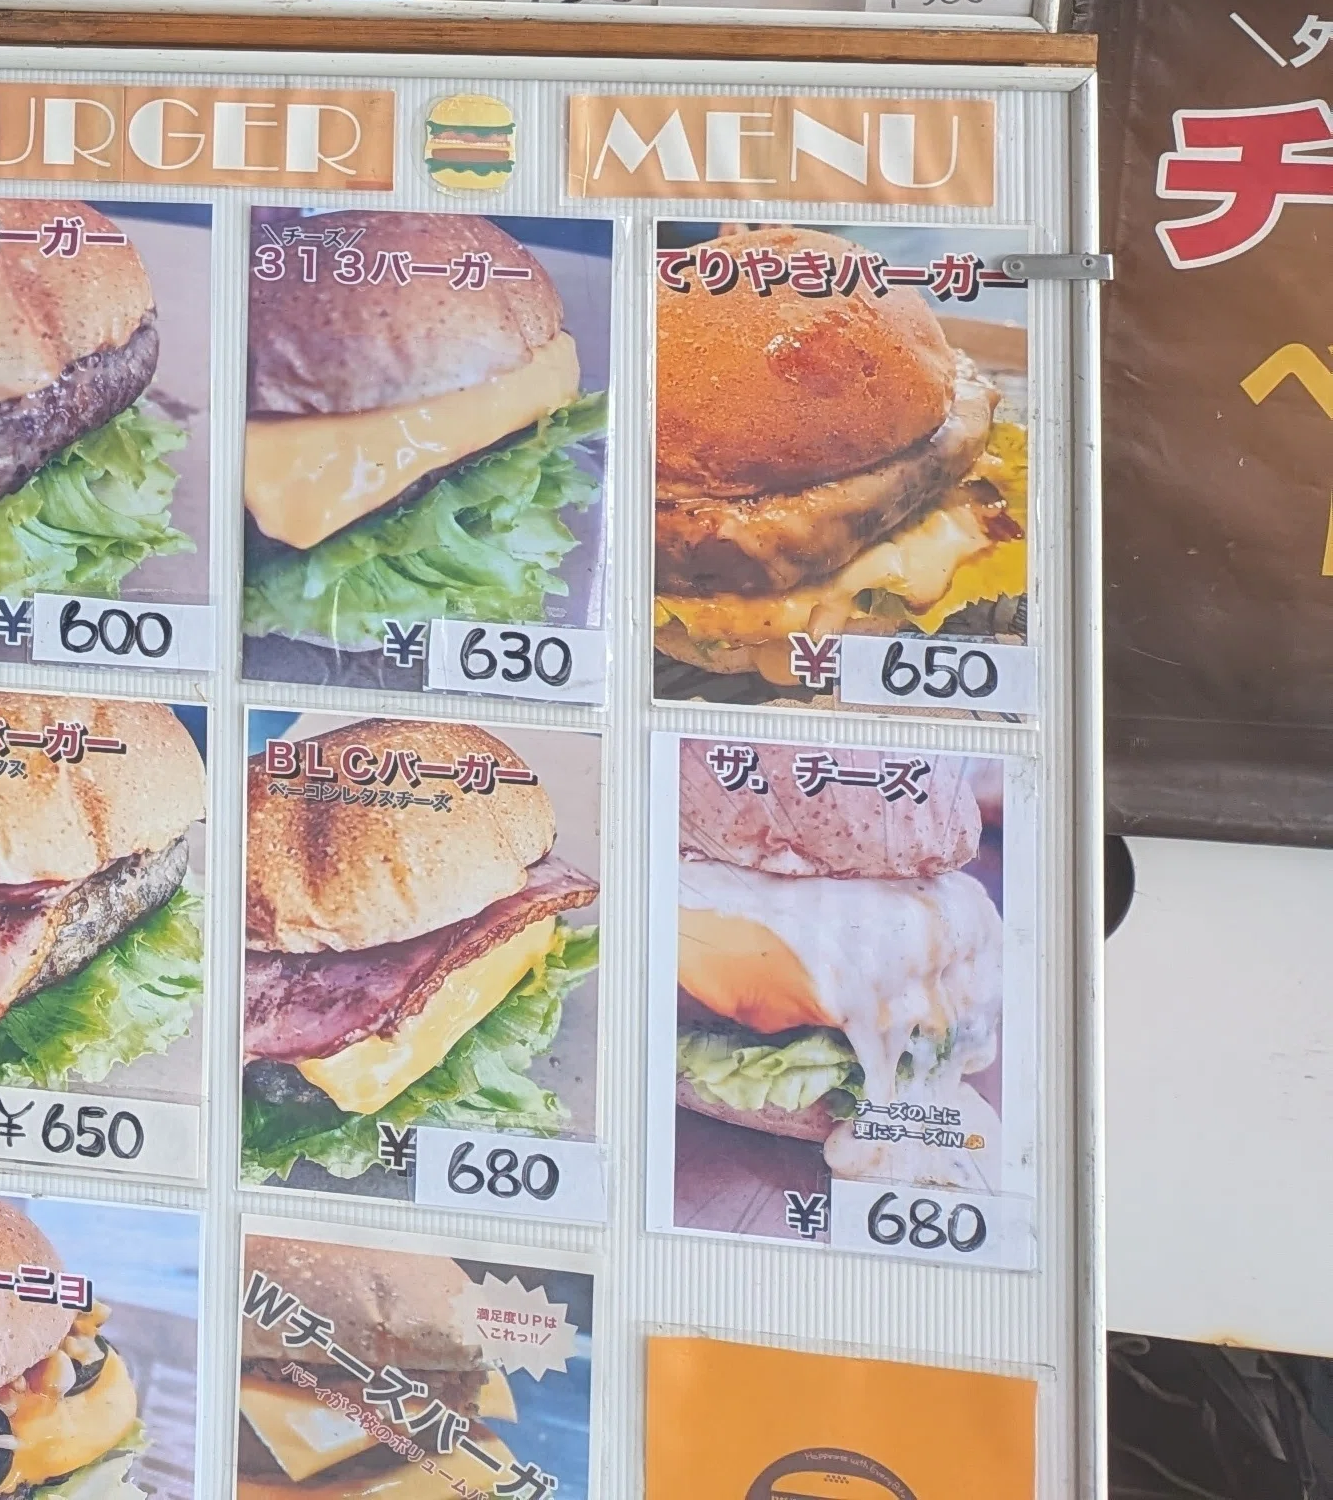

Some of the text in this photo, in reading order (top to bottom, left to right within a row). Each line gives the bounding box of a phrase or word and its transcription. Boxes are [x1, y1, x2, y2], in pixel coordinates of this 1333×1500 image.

[592, 107, 960, 190] MENU
[281, 225, 347, 248] チーズ
[268, 779, 454, 813] ベーコンレタスチーズ
[854, 1098, 962, 1126] チーズの上に
